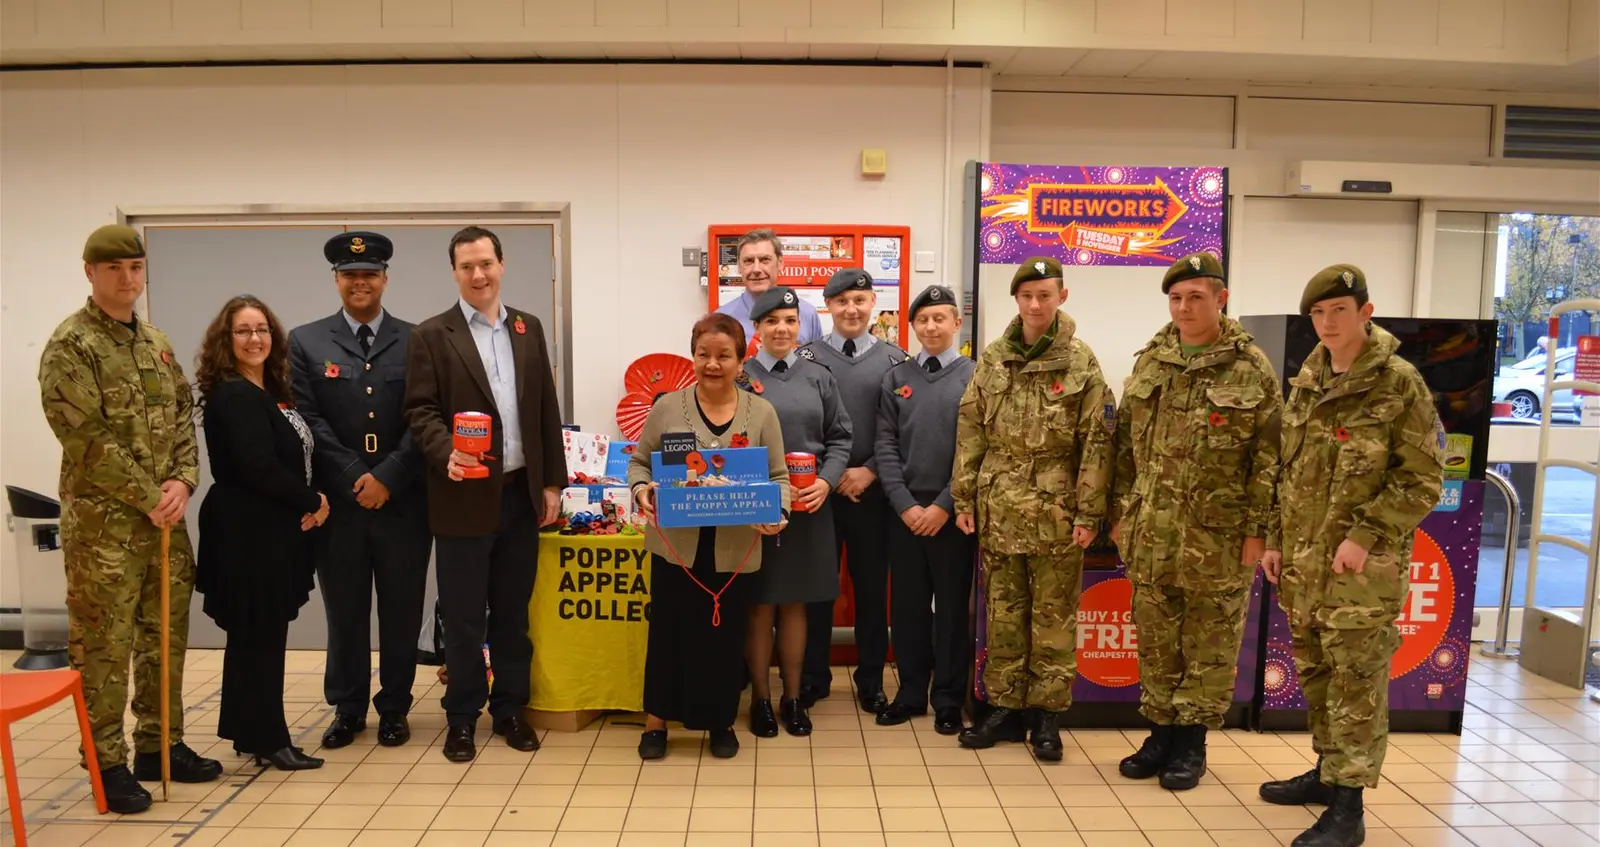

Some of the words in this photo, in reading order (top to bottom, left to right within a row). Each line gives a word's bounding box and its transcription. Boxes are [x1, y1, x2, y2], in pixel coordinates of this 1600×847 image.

[1041, 198, 1165, 217] FIREWORKS
[1076, 229, 1126, 246] TUESDAY
[1082, 240, 1121, 253] NOVEMBER
[778, 266, 808, 277] MIDI
[457, 426, 487, 435] APPEAL
[664, 444, 694, 452] LEGION
[730, 492, 757, 500] HELP
[1450, 488, 1460, 497] &
[671, 503, 692, 511] THE
[695, 501, 729, 509] POPPY
[732, 500, 772, 508] APPEAL
[1438, 497, 1458, 506] TCH
[559, 546, 648, 570] POPPY
[1429, 562, 1440, 580] 1
[558, 571, 648, 594] APPEA
[558, 598, 652, 622] COLLEC
[1077, 610, 1108, 622] BUY
[1111, 610, 1119, 622] 1
[1122, 610, 1132, 622] G
[1076, 624, 1138, 649] FRE
[1083, 651, 1126, 659] CHEAPEST
[1127, 651, 1139, 659] FR
